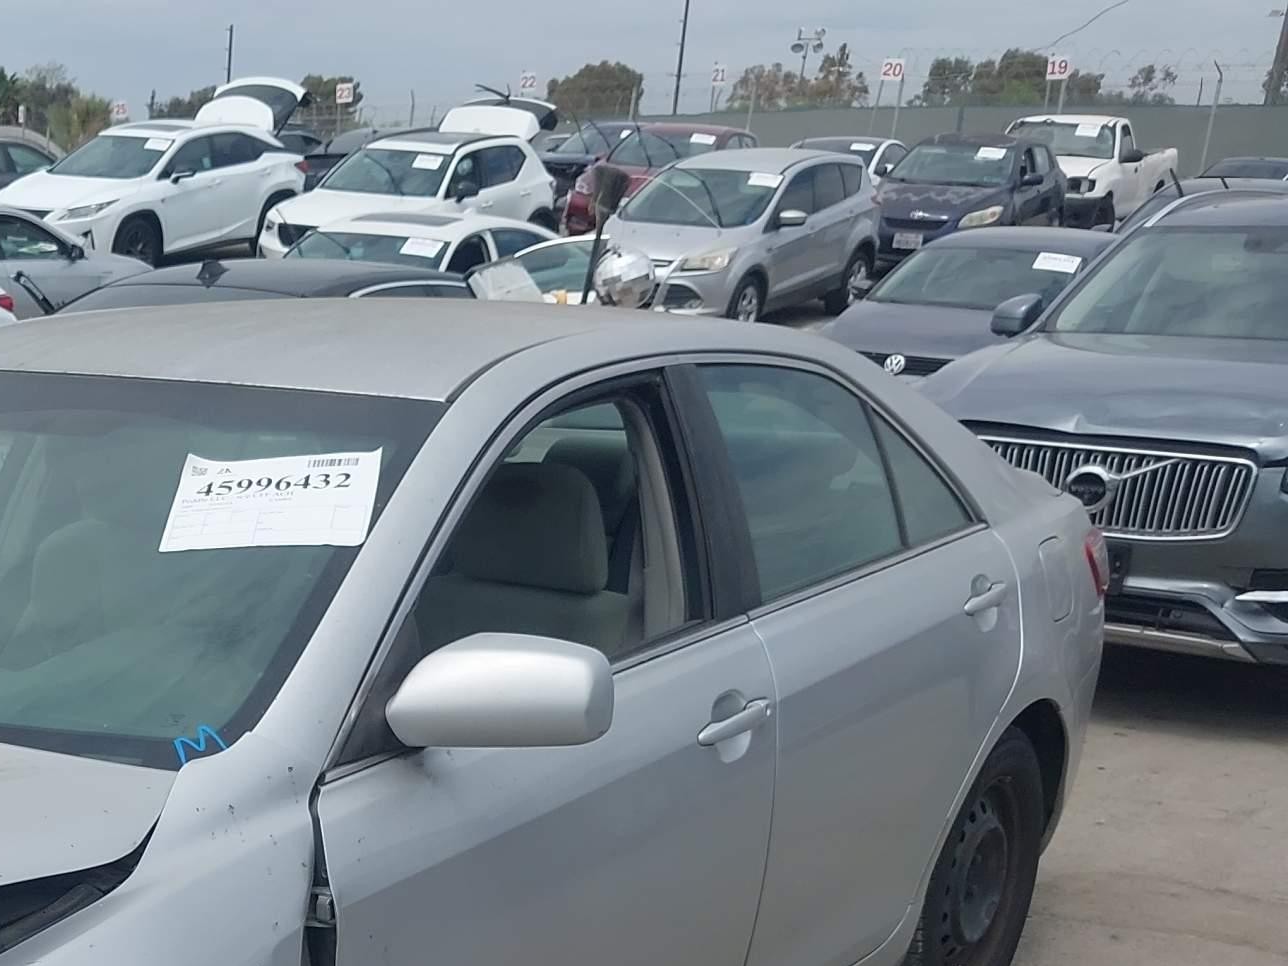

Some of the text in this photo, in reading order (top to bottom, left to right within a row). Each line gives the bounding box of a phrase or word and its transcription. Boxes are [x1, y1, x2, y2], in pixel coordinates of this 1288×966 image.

[882, 63, 903, 77] 20
[1048, 60, 1068, 75] 19
[521, 76, 536, 88] 22
[712, 68, 725, 82] 21
[337, 88, 351, 99] 23
[196, 472, 352, 497] 45996432
[173, 725, 227, 764] M
